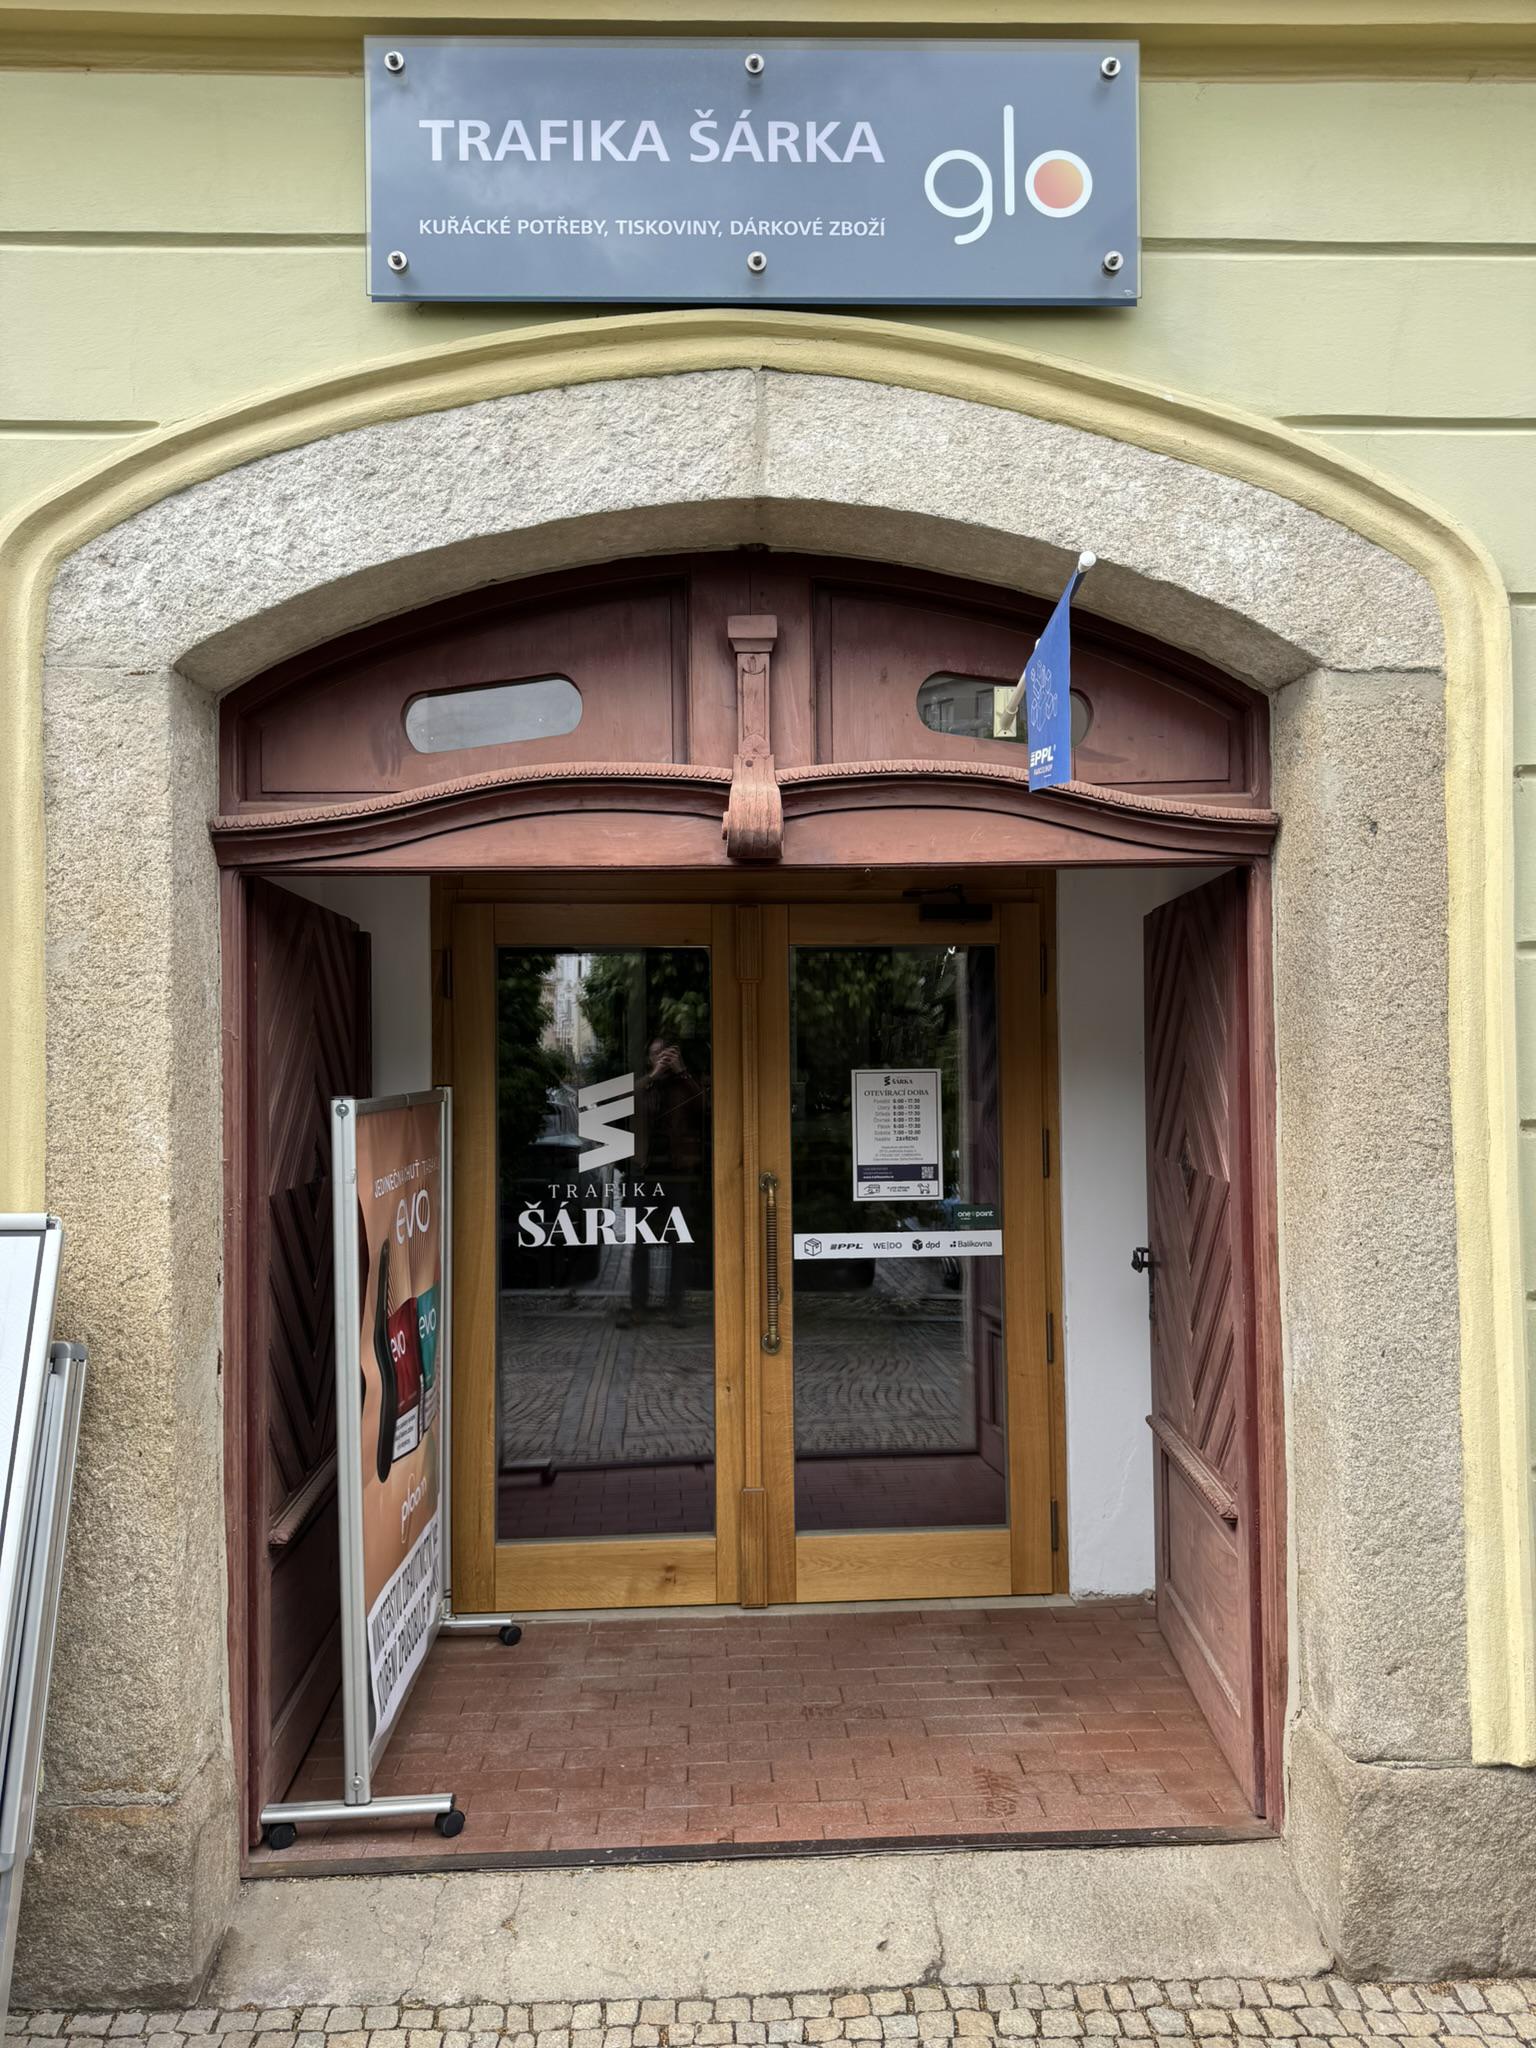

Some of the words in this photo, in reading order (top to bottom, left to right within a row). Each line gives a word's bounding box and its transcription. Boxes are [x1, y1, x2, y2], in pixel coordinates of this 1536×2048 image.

[419, 119, 670, 163] TRAFIKA
[689, 109, 886, 164] ŠÁRKA
[923, 104, 1093, 246] glo
[418, 216, 512, 235] KUŘÁCKÉ
[517, 216, 610, 239] POTŘEBY,
[615, 219, 724, 239] TISKOVINY,
[729, 218, 823, 237] DÁRKOVÉ
[828, 217, 886, 237] ZBOŽÍ
[864, 1088, 906, 1097] OTEVÍRACÍ
[548, 1183, 666, 1199] TRAFIKA
[396, 1188, 430, 1244] evo
[517, 1201, 695, 1248] ŠÁRKA
[926, 1240, 941, 1251] dpd
[419, 1308, 437, 1339] evo
[401, 1472, 427, 1543] ploom
